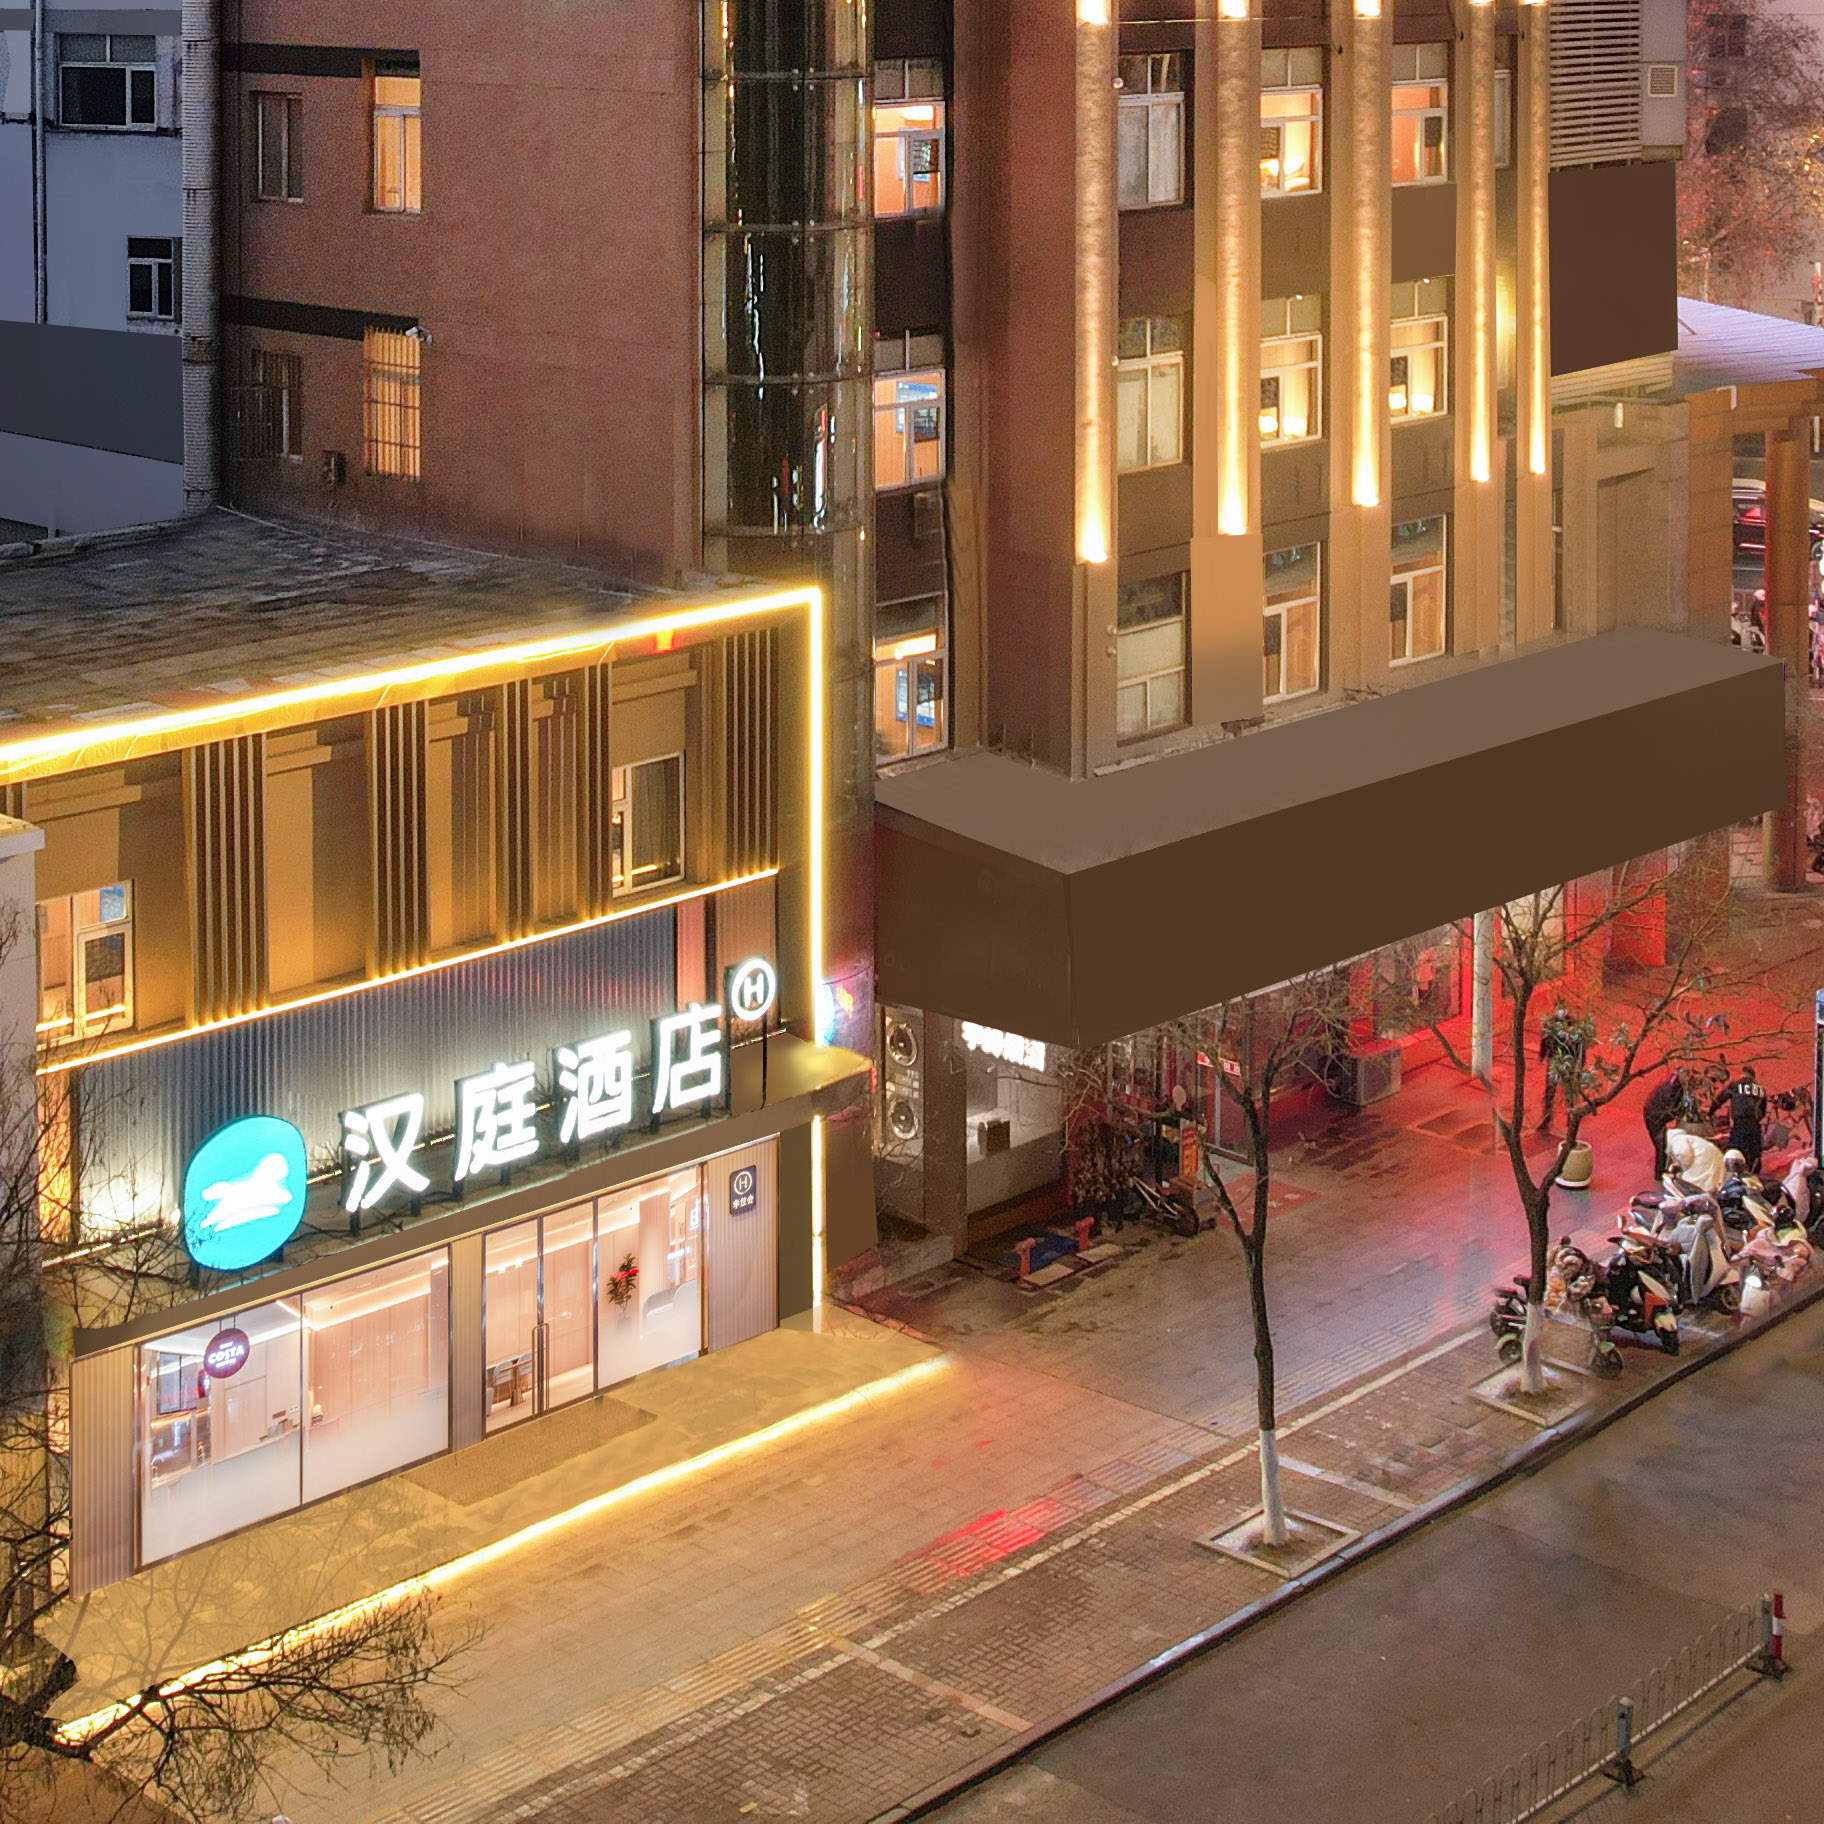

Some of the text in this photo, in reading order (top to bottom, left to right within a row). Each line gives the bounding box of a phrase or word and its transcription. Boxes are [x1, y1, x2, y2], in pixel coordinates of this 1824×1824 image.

[344, 1002, 722, 1213] 汉庭酒店
[207, 1344, 244, 1364] COSTA
